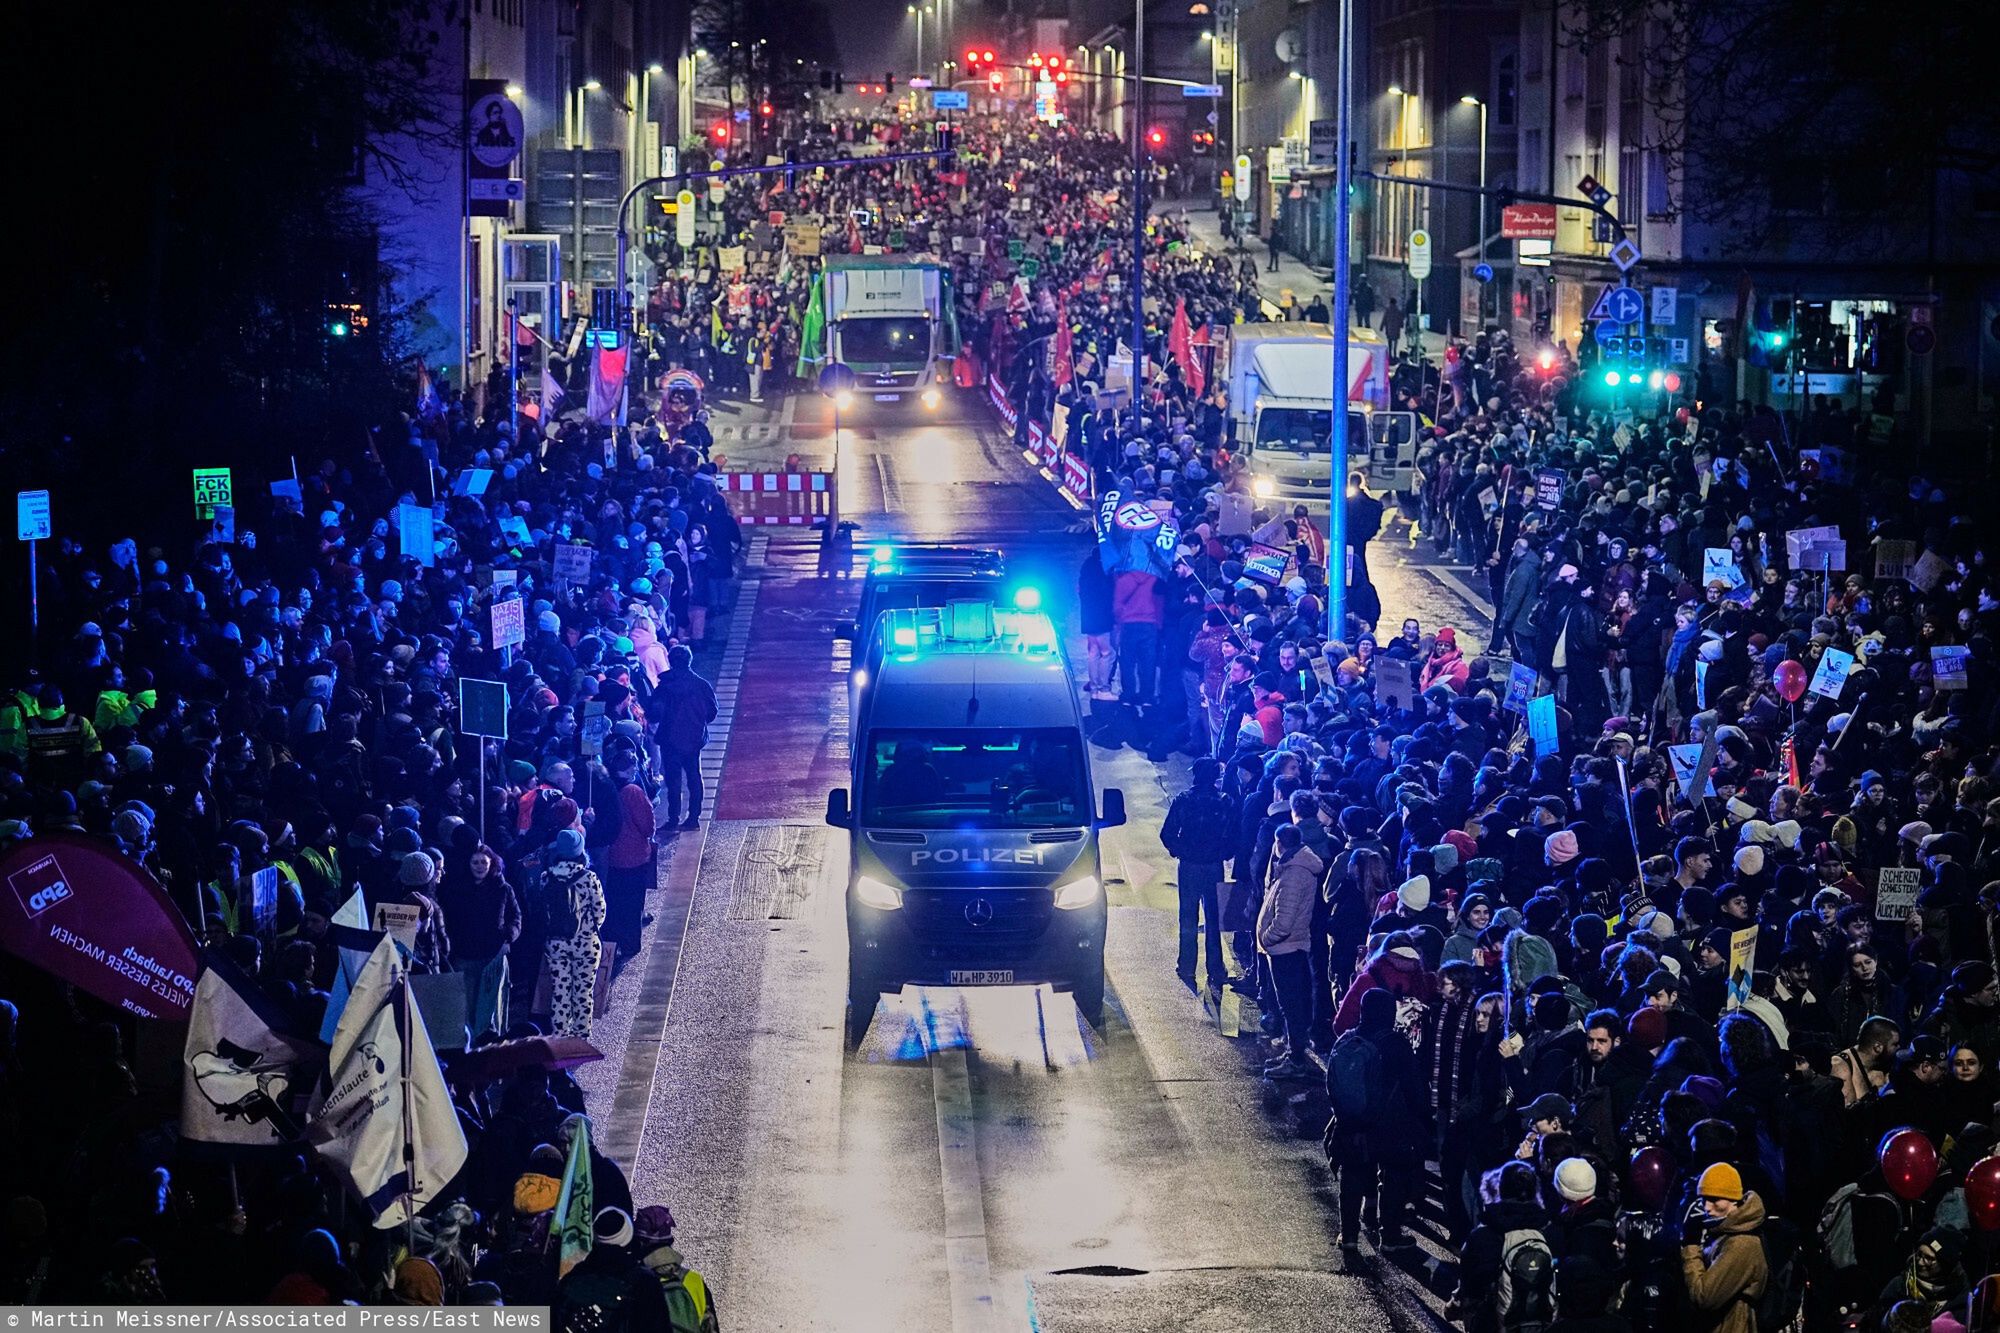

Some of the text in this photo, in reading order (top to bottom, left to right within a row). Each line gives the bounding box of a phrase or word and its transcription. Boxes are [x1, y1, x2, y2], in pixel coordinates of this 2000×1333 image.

[195, 478, 229, 491] FCK
[196, 490, 230, 503] AFD
[1878, 564, 1912, 577] BUNT
[492, 601, 519, 616] NAZIS
[494, 623, 520, 638] NAZIS
[1935, 656, 1962, 668] STOPPT
[911, 848, 1044, 866] POLIZEI
[1882, 869, 1920, 884] SCHEREN
[951, 971, 1012, 983] WI HP 3910
